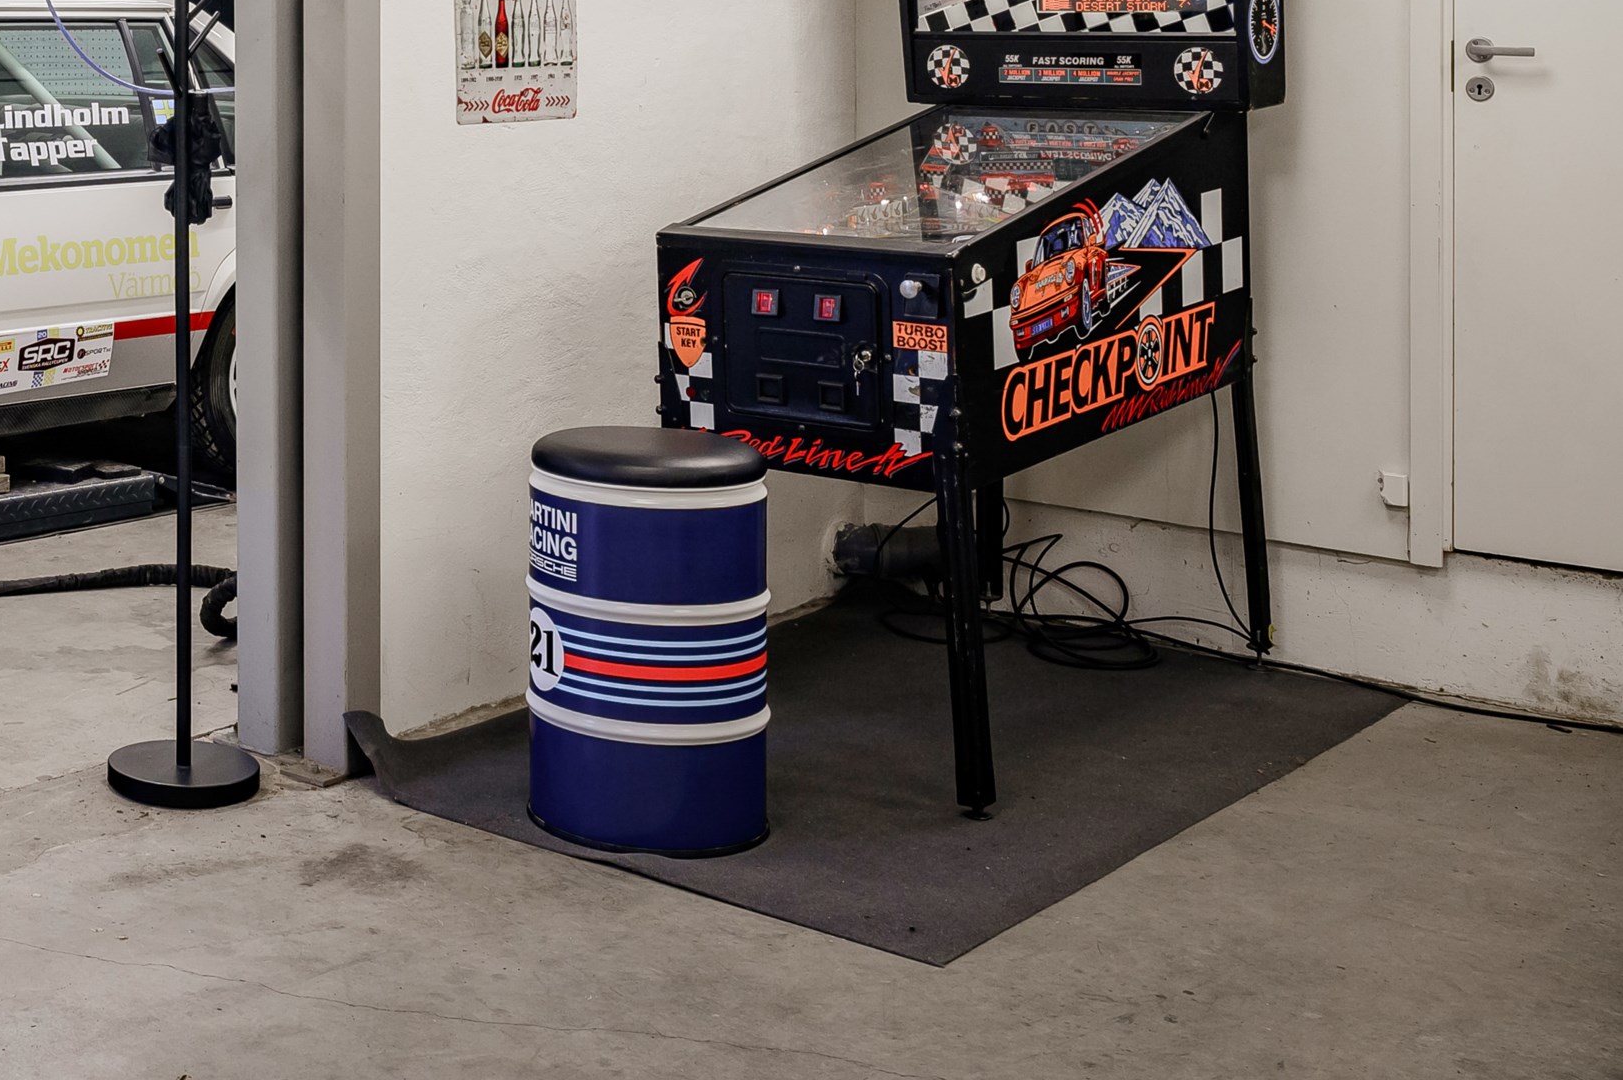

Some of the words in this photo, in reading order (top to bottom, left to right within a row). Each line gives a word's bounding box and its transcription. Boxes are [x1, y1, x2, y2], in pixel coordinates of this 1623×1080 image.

[1076, 2, 1121, 12] DESERT
[1127, 1, 1167, 12] STORM
[1005, 55, 1020, 63] 55K
[1032, 57, 1057, 65] FAST
[1059, 57, 1104, 66] SCORING
[1117, 56, 1132, 64] 55K
[108, 266, 202, 299] Värmö
[677, 327, 701, 338] START
[897, 323, 945, 339] TURBO
[681, 337, 697, 349] KEY
[896, 336, 946, 351] BOOST
[22, 341, 71, 365] SRC
[1002, 302, 1215, 441] CHECKPOINT
[529, 499, 577, 534] ARTINI
[529, 522, 577, 561] ACING
[529, 551, 577, 578] RSCHE
[530, 620, 559, 677] 21
